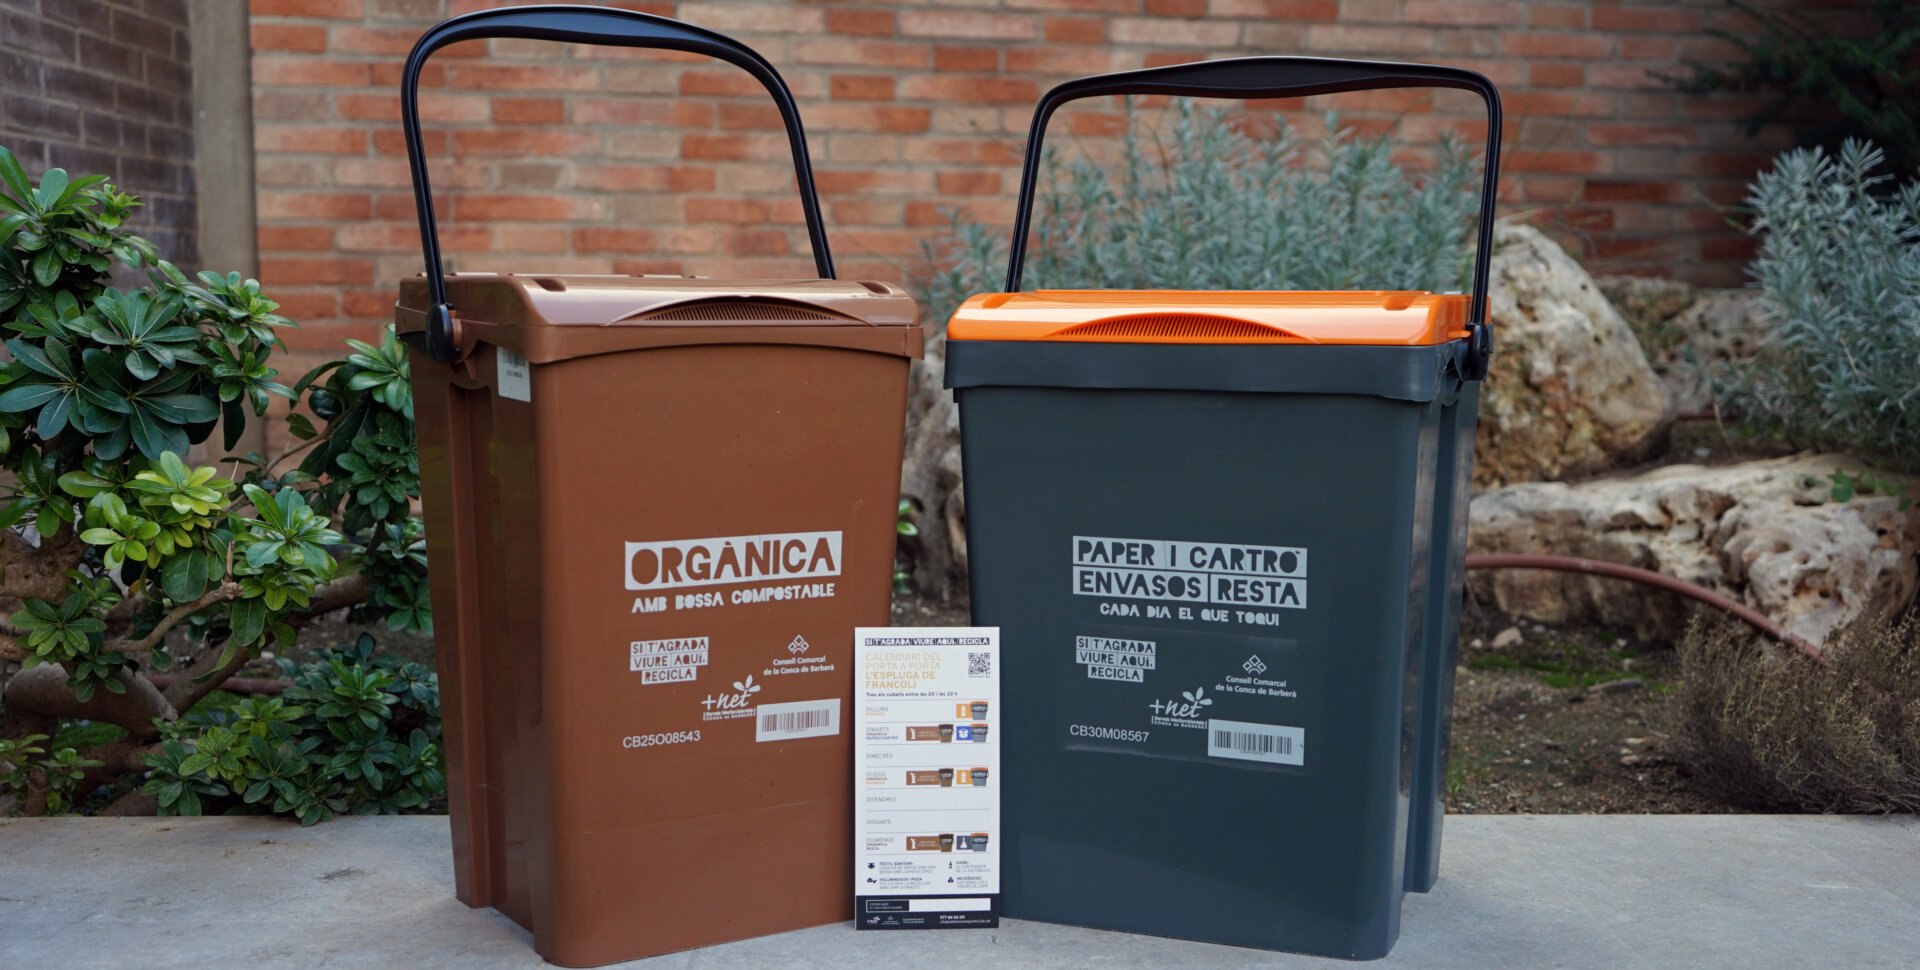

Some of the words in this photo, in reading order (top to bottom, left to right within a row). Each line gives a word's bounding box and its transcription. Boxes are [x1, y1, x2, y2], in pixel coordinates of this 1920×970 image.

[1078, 540, 1155, 566] PAPER
[1170, 545, 1177, 567] I
[631, 537, 836, 585] ORGÀNICA
[1079, 570, 1201, 599] ENVASOS
[1217, 578, 1300, 605] RESTA
[631, 596, 667, 613] AMB
[675, 592, 724, 610] BOSSA
[731, 583, 835, 605] COMPOSTABLE
[1100, 602, 1140, 617] CADA
[1147, 605, 1171, 619] DIA
[1178, 607, 1194, 620] EL
[1201, 608, 1229, 623] QUE
[1236, 610, 1279, 626] TOQUI
[633, 643, 643, 654] SI
[648, 638, 706, 653] T'AGRADA
[1078, 638, 1088, 648] SI
[1093, 639, 1154, 654] T'AGRADA
[634, 655, 668, 668] VIURE
[773, 657, 796, 666] Consell
[797, 655, 826, 664] Comarcal
[866, 653, 920, 661] CALENDARI
[923, 653, 942, 661] DEL
[1080, 651, 1114, 664] VIURE
[763, 668, 772, 676] de
[866, 662, 897, 670] PORTA
[900, 662, 906, 670] A
[909, 662, 940, 670] PORTA
[1091, 666, 1140, 680] RECICLA
[645, 668, 693, 682] RECICLA
[866, 671, 919, 680] L'ESPLUGA
[922, 671, 936, 679] DE
[1225, 675, 1252, 684] Consell
[1253, 678, 1287, 688] Comarcal
[1215, 683, 1225, 691] de
[1226, 684, 1233, 692] la
[1234, 685, 1256, 694] Conca
[1257, 687, 1267, 695] de
[1268, 688, 1297, 698] Barberà
[1070, 724, 1150, 743] CB30M08567
